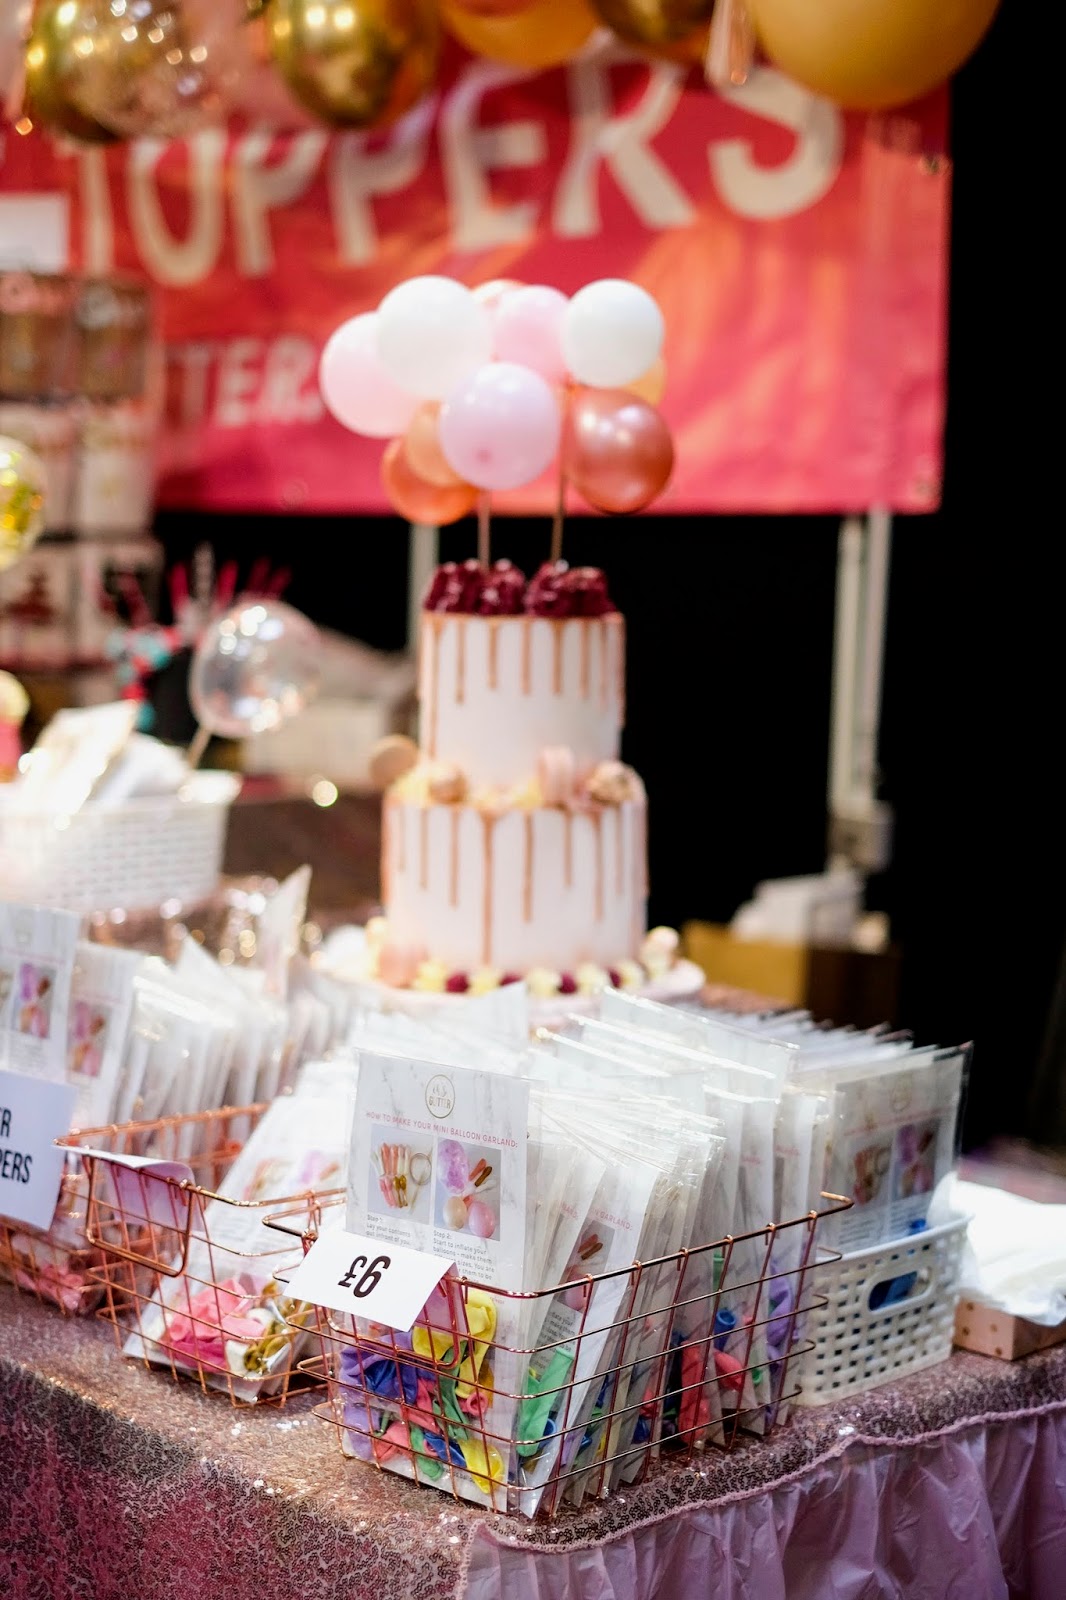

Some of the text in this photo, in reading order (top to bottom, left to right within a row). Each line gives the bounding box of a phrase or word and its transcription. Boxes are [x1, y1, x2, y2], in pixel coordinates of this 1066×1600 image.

[54, 28, 845, 286] TOPPERS
[0, 1107, 12, 1138] R
[366, 1111, 518, 1148] HOW TO MAKE YOUR MINI BALLOON GARLAND:
[0, 1148, 33, 1185] ERS
[433, 1229, 445, 1239] Step
[433, 1237, 447, 1246] Start
[454, 1243, 473, 1252] inflate
[473, 1247, 487, 1255] your
[433, 1246, 456, 1256] balloons
[460, 1252, 476, 1261] make
[477, 1256, 492, 1264] them
[457, 1260, 473, 1268] sizes.
[474, 1262, 485, 1271] You
[338, 1255, 391, 1298] £6
[462, 1268, 476, 1276] them
